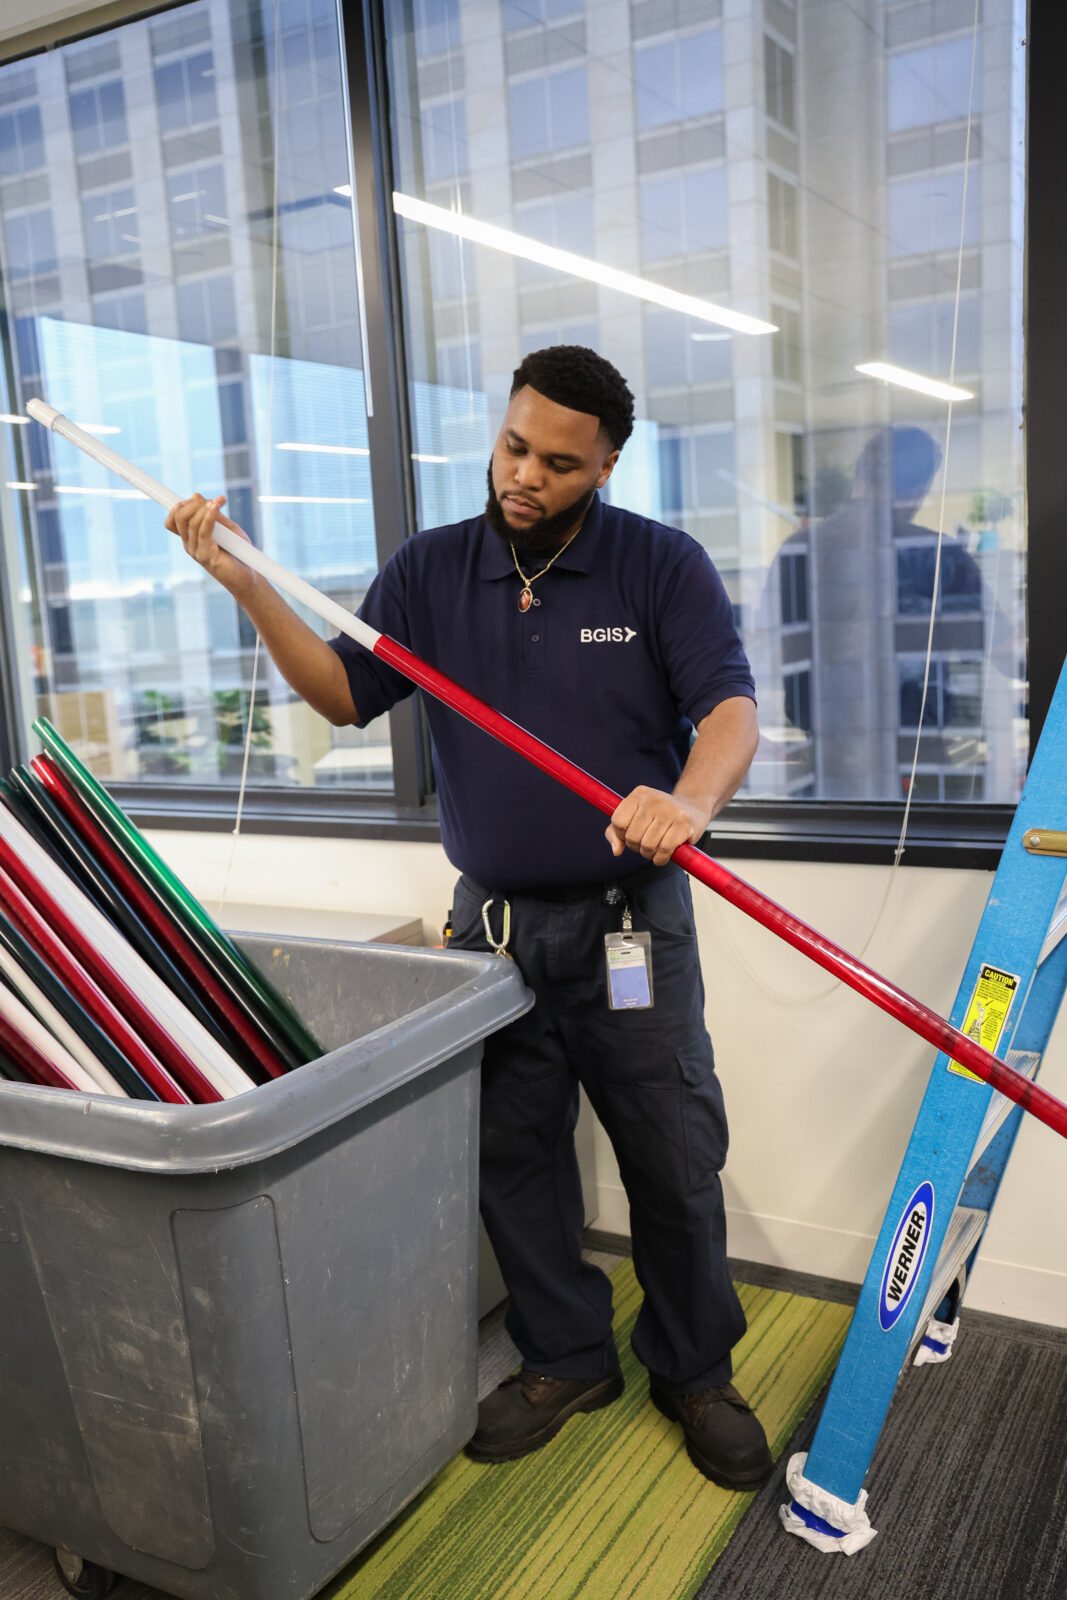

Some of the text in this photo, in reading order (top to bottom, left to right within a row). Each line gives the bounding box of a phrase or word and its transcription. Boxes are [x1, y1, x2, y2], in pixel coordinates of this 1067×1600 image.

[580, 627, 624, 643] BGIS
[984, 969, 1014, 987] CAUTION
[887, 1210, 925, 1302] WERNER
